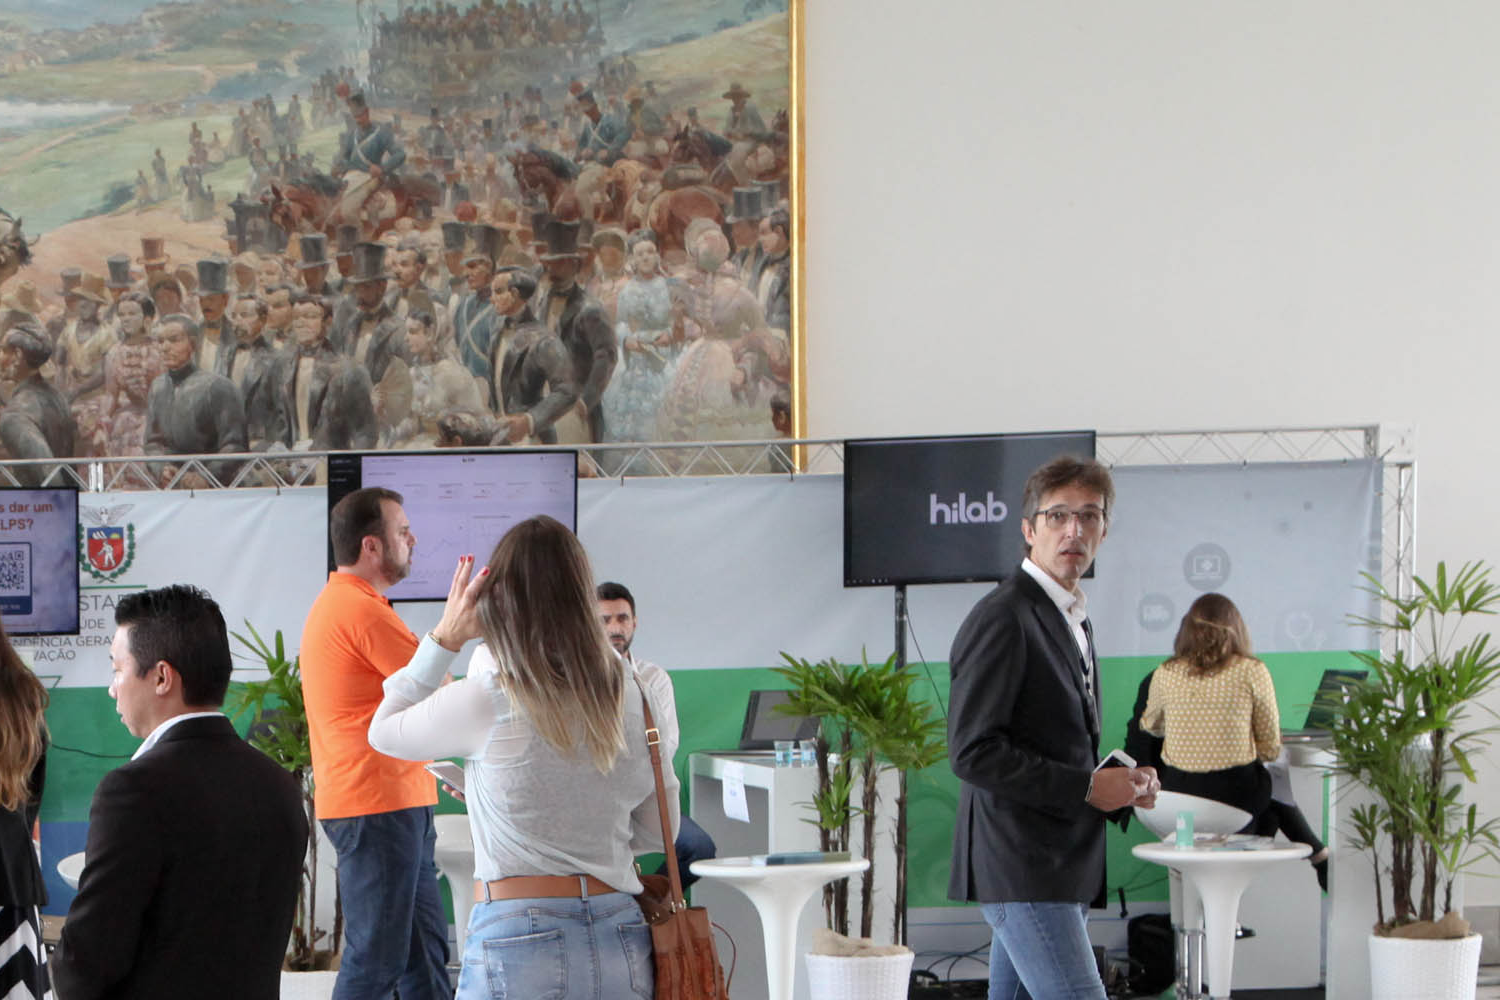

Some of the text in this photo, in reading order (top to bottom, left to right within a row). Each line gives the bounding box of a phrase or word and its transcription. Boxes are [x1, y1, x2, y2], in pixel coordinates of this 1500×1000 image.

[9, 502, 30, 513] dar
[33, 503, 54, 513] um
[930, 491, 1008, 525] hilab
[76, 635, 115, 647] GERA
